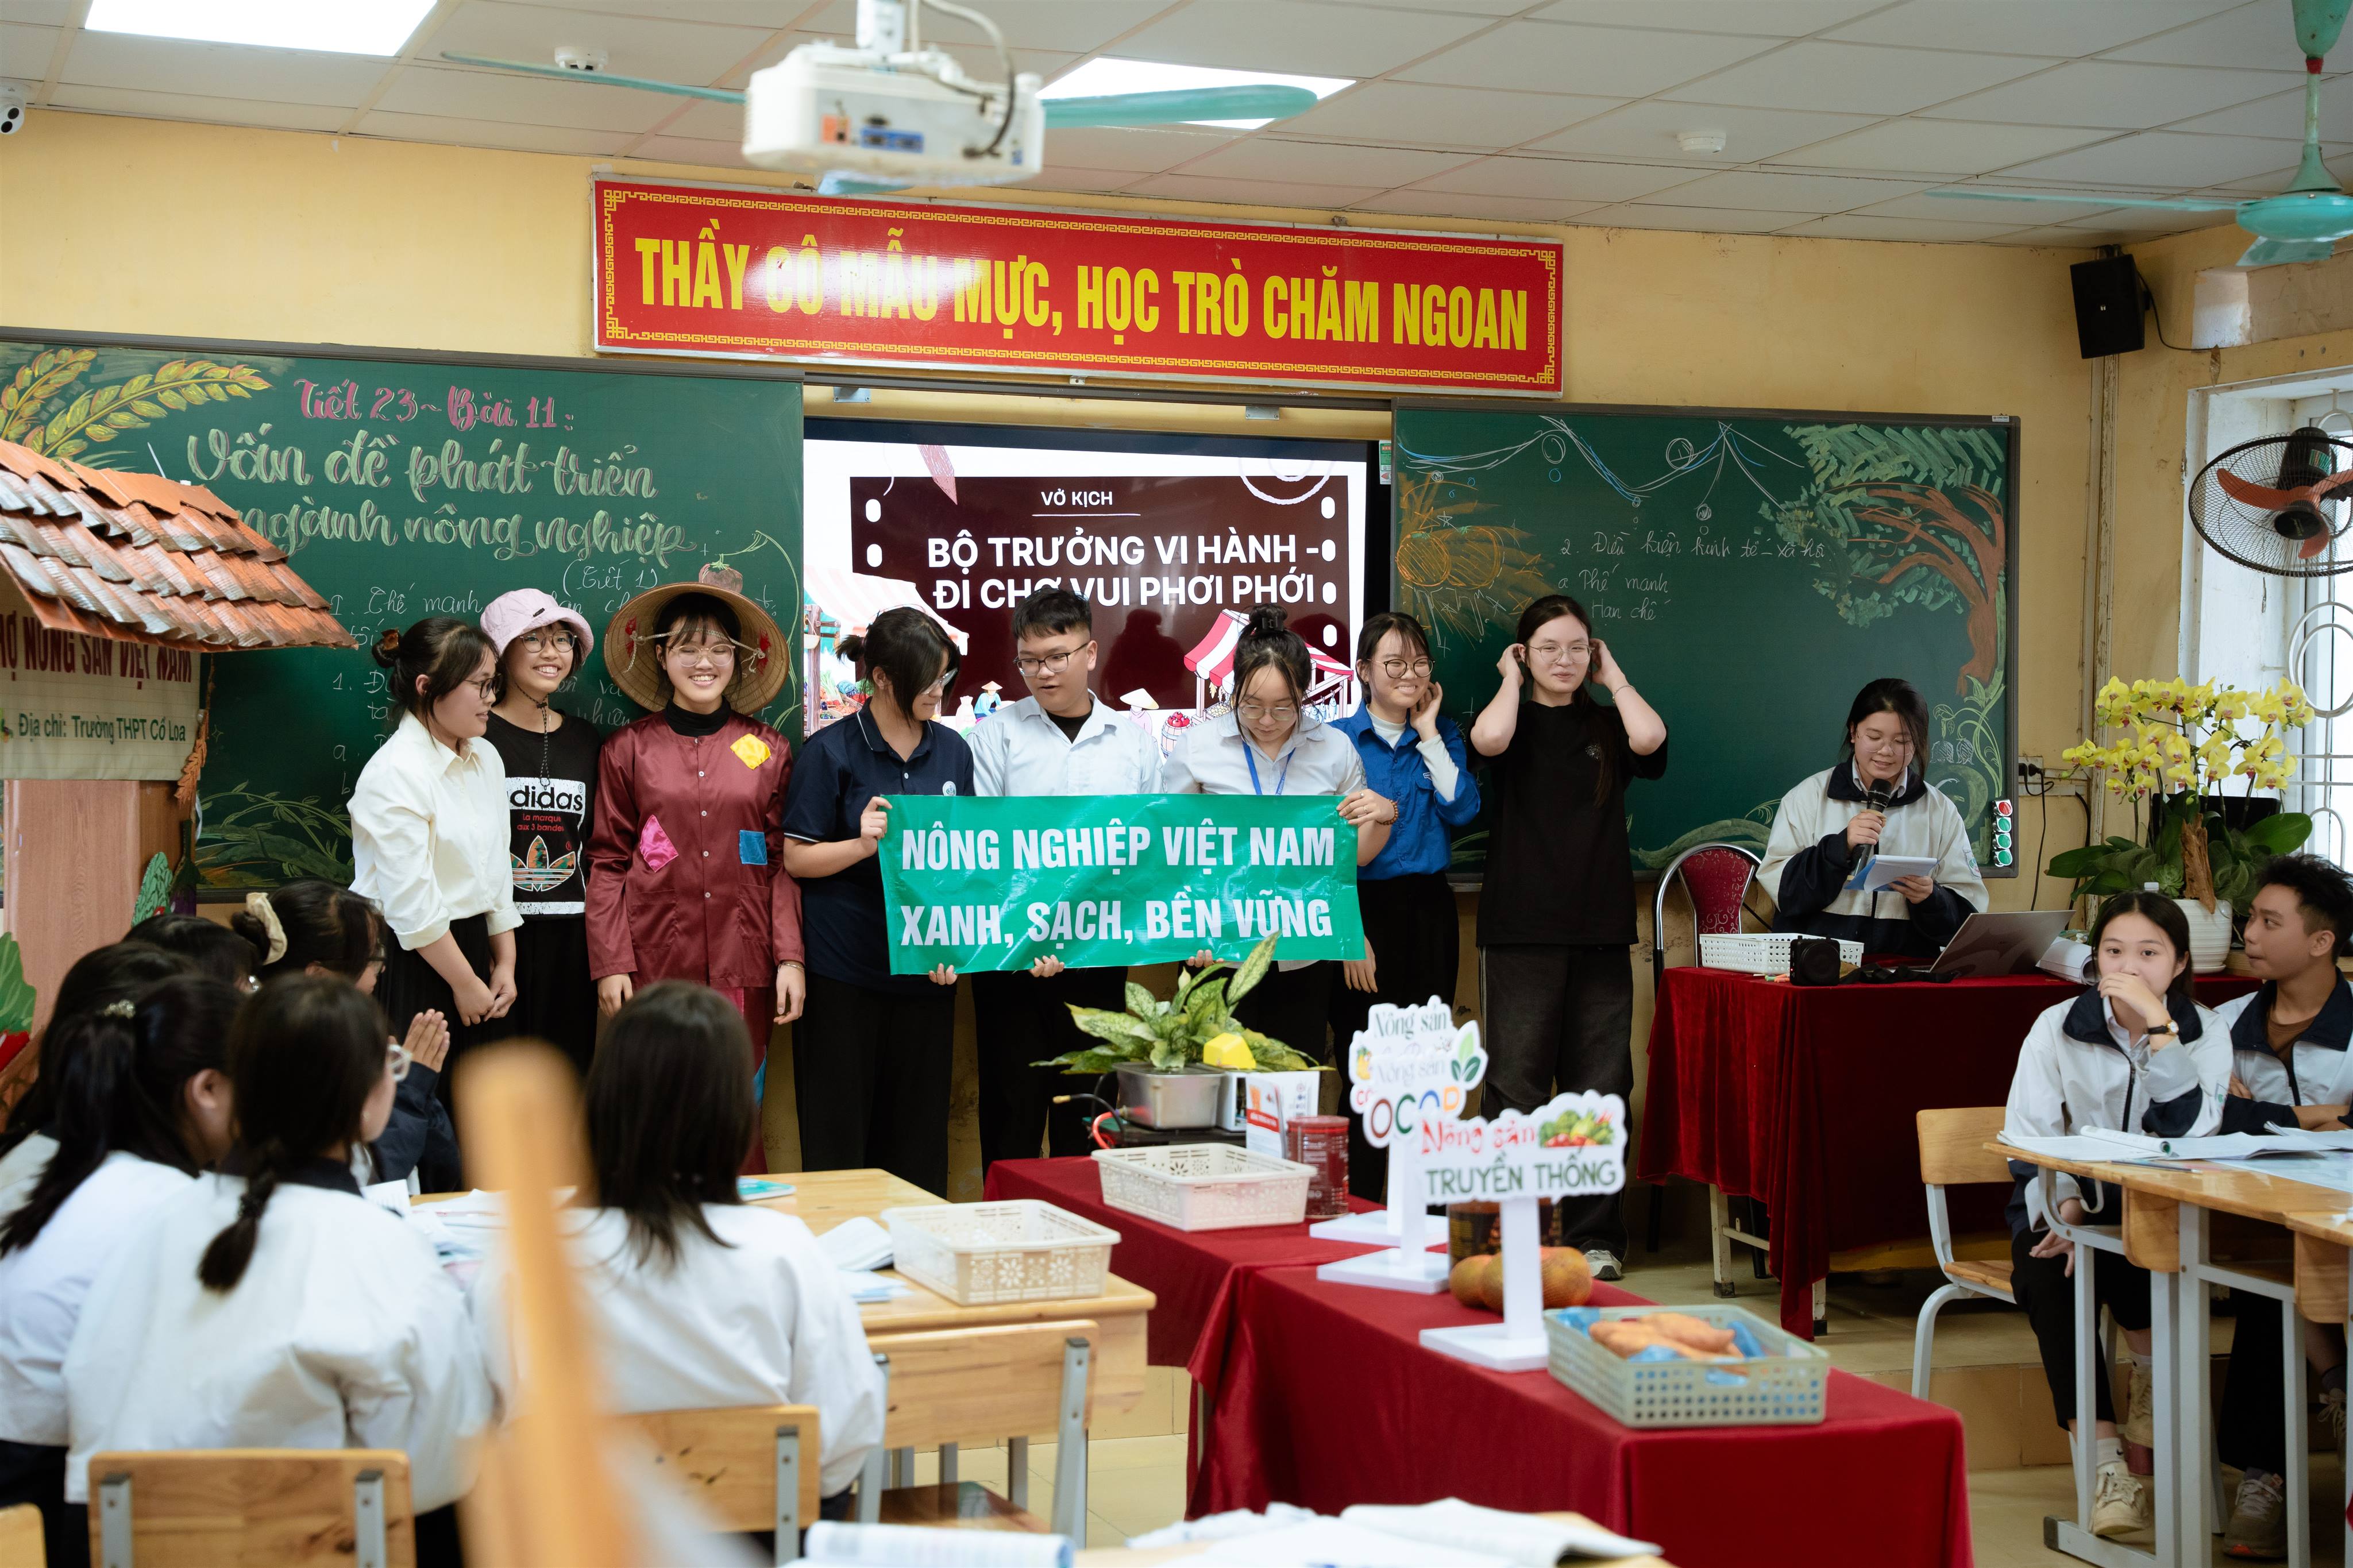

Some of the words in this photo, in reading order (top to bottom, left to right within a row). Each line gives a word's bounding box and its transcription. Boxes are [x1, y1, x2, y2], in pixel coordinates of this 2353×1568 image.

[635, 218, 750, 311] THẦY
[765, 234, 824, 315] CÔ
[839, 227, 938, 321] MẪU
[953, 255, 1062, 339] MỰC,
[1077, 265, 1159, 344] HỌC
[1172, 258, 1249, 337] TRÒ
[1263, 265, 1379, 342] CHĂM
[1393, 282, 1527, 351] NGOAN
[294, 378, 362, 420] Tiết
[369, 387, 418, 422] 23
[448, 385, 517, 431] Bài
[525, 396, 574, 431] 11:
[187, 423, 314, 486] Vấn
[325, 429, 400, 488] đề
[404, 438, 539, 503] phát
[540, 444, 659, 499] triển
[1040, 488, 1066, 506] VỞ
[1072, 491, 1113, 509] KỊCH
[404, 503, 538, 561] nông
[535, 509, 697, 569] nghiệp
[927, 528, 978, 575] BỘ
[987, 527, 1145, 567] TRƯỞNG
[1154, 535, 1188, 565] VI
[1197, 527, 1297, 564] HÀNH
[932, 578, 970, 609] ĐI
[1140, 574, 1223, 606] PHƠI
[1232, 566, 1315, 605] PHỚI
[19, 713, 40, 743] Địa
[44, 713, 67, 737] chỉ:
[71, 715, 114, 745] Trường
[116, 717, 147, 740] THPT
[168, 720, 186, 741] Loa
[507, 785, 583, 811] didas
[533, 814, 561, 822] marque
[902, 821, 1000, 871] NÔNG
[1013, 818, 1151, 875] NGHIỆP
[1162, 818, 1238, 875] VIỆT
[1251, 827, 1334, 867] NAM
[901, 905, 1015, 948] XANH,
[1027, 899, 1133, 949] SẠCH,
[1146, 885, 1221, 940] BỀN
[1229, 889, 1334, 937] VỮNG
[1421, 1119, 1483, 1155] Nông
[1426, 1150, 1523, 1195] TRUYỀN
[1534, 1145, 1616, 1189] THỐNG
